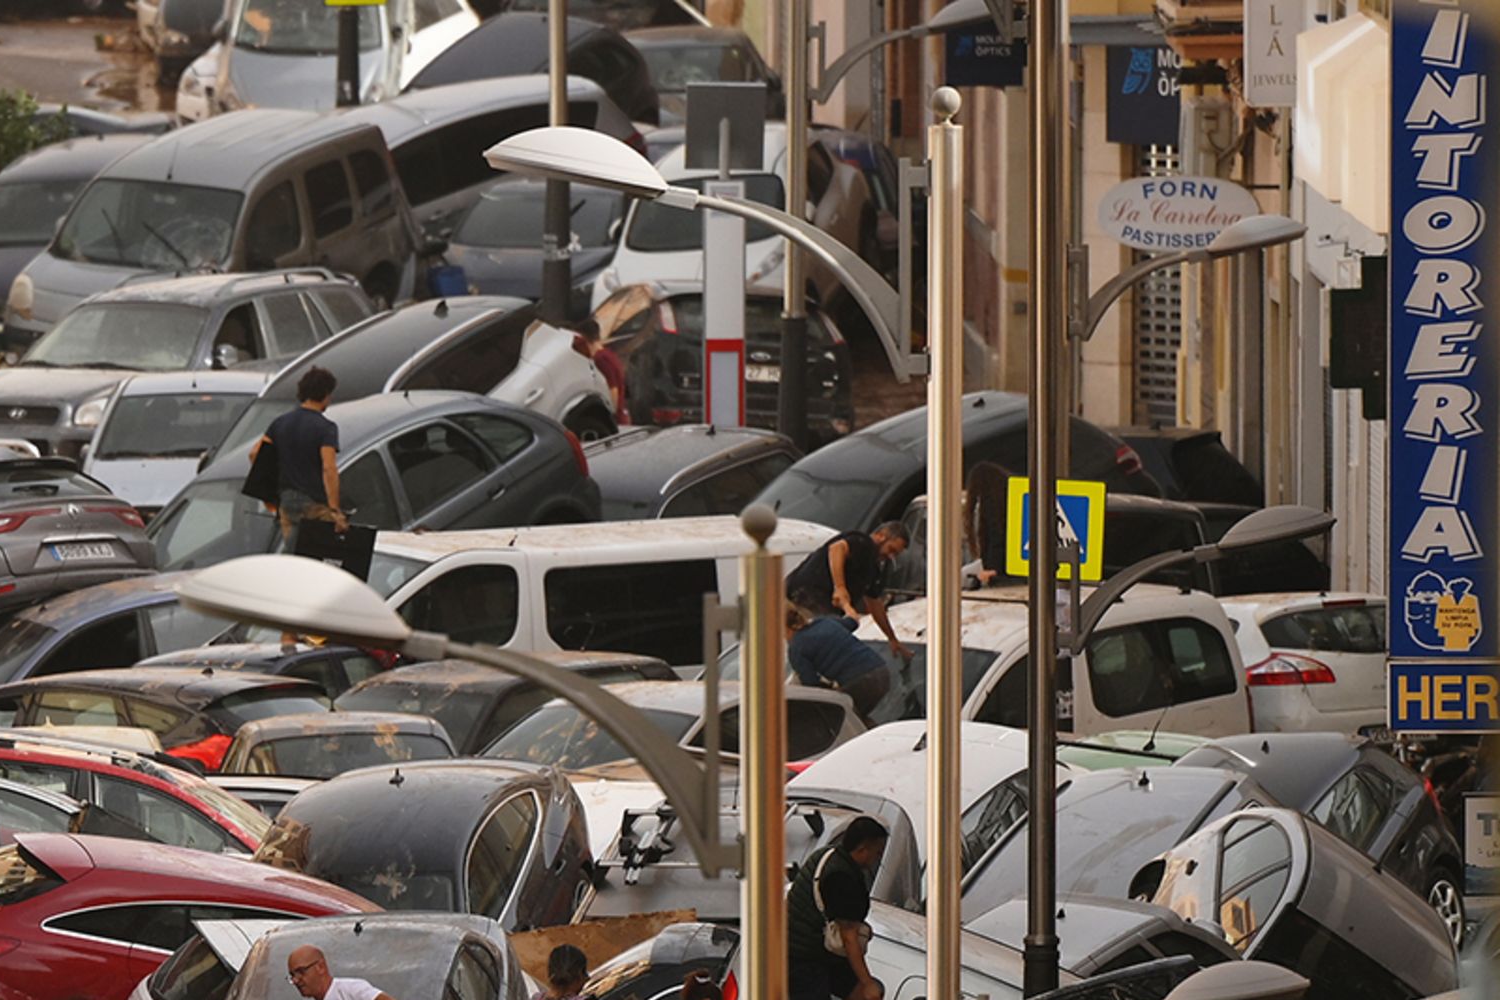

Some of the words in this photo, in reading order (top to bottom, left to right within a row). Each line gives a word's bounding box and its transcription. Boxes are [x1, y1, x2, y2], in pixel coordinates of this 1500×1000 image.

[1141, 181, 1218, 201] FORN
[1109, 200, 1140, 223] La
[1121, 225, 1221, 248] PASTISSER
[1401, 0, 1486, 563] INTORERIA
